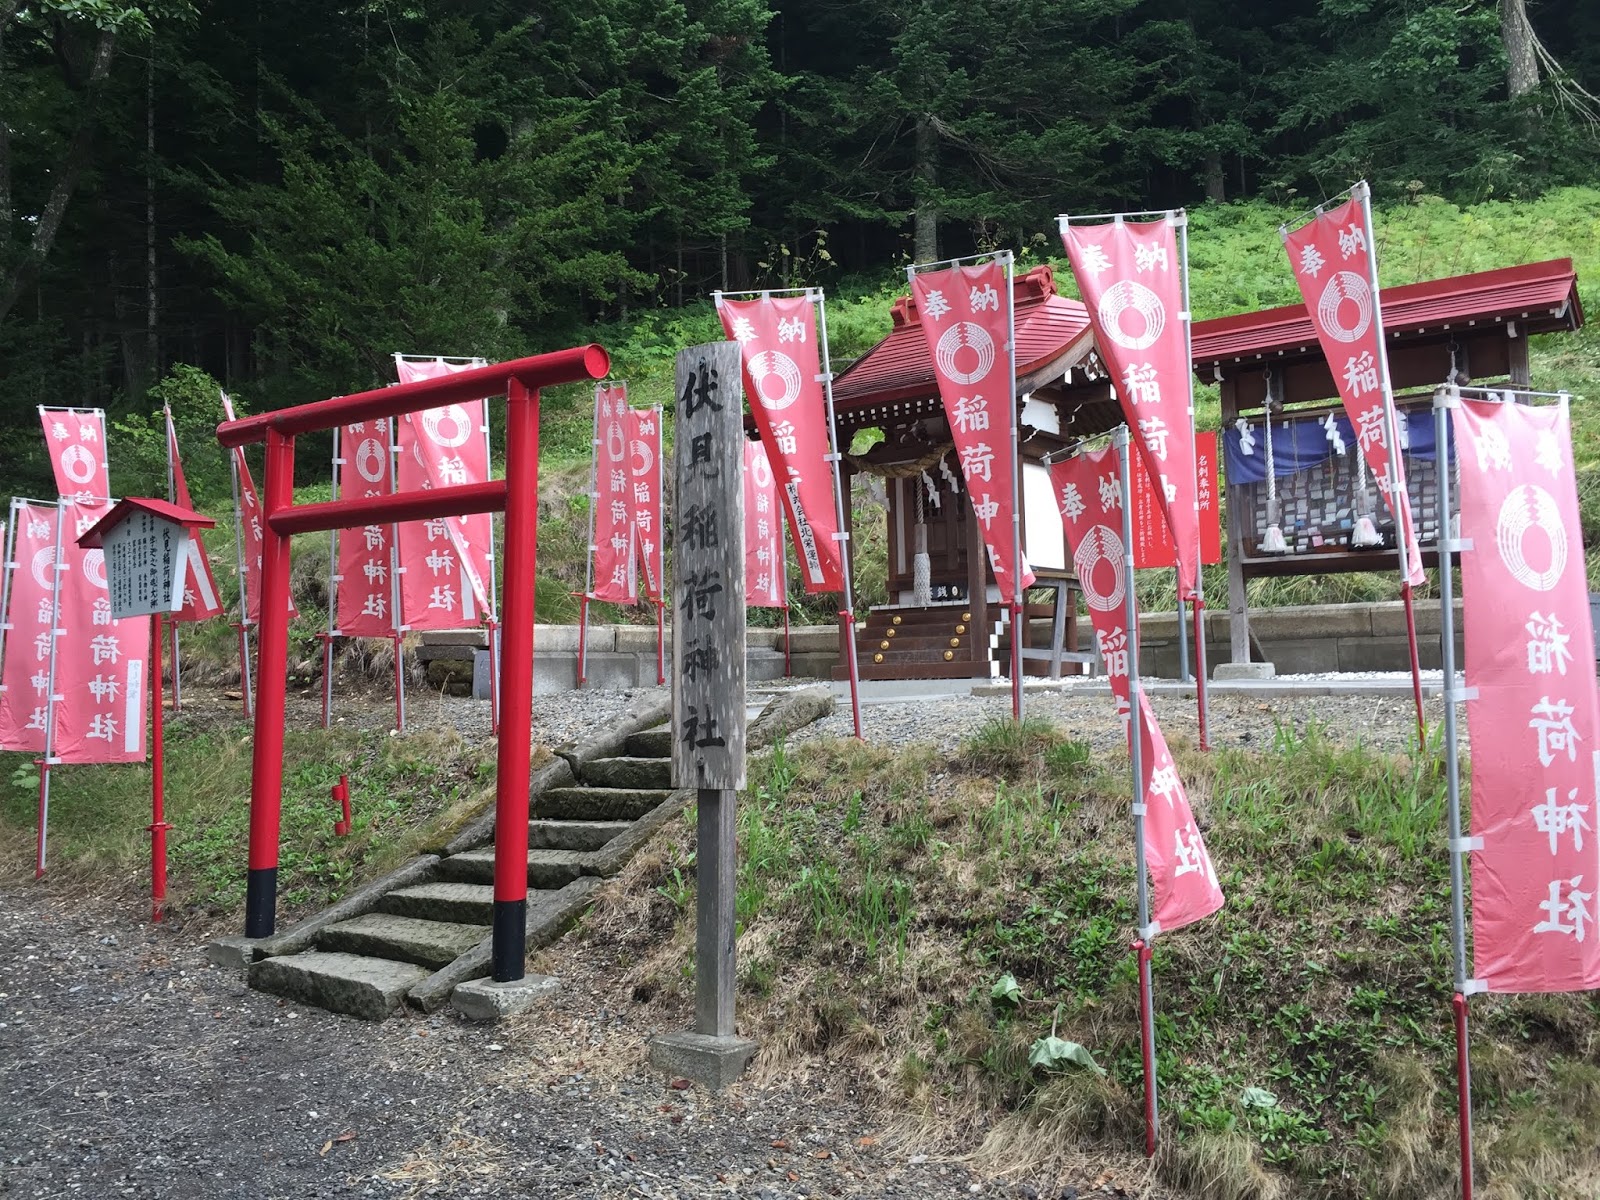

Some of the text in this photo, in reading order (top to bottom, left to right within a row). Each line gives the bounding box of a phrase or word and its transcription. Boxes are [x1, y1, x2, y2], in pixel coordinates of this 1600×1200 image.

[1080, 241, 1168, 277] 奉納
[1300, 223, 1368, 278] 奉納
[923, 284, 999, 322] 奉納
[732, 316, 806, 347] 奉納
[52, 422, 97, 442] 奉納
[1061, 472, 1123, 524] 奉納
[163, 528, 171, 603] 伏見稲荷神社
[681, 367, 725, 752] 伏見稲荷神社
